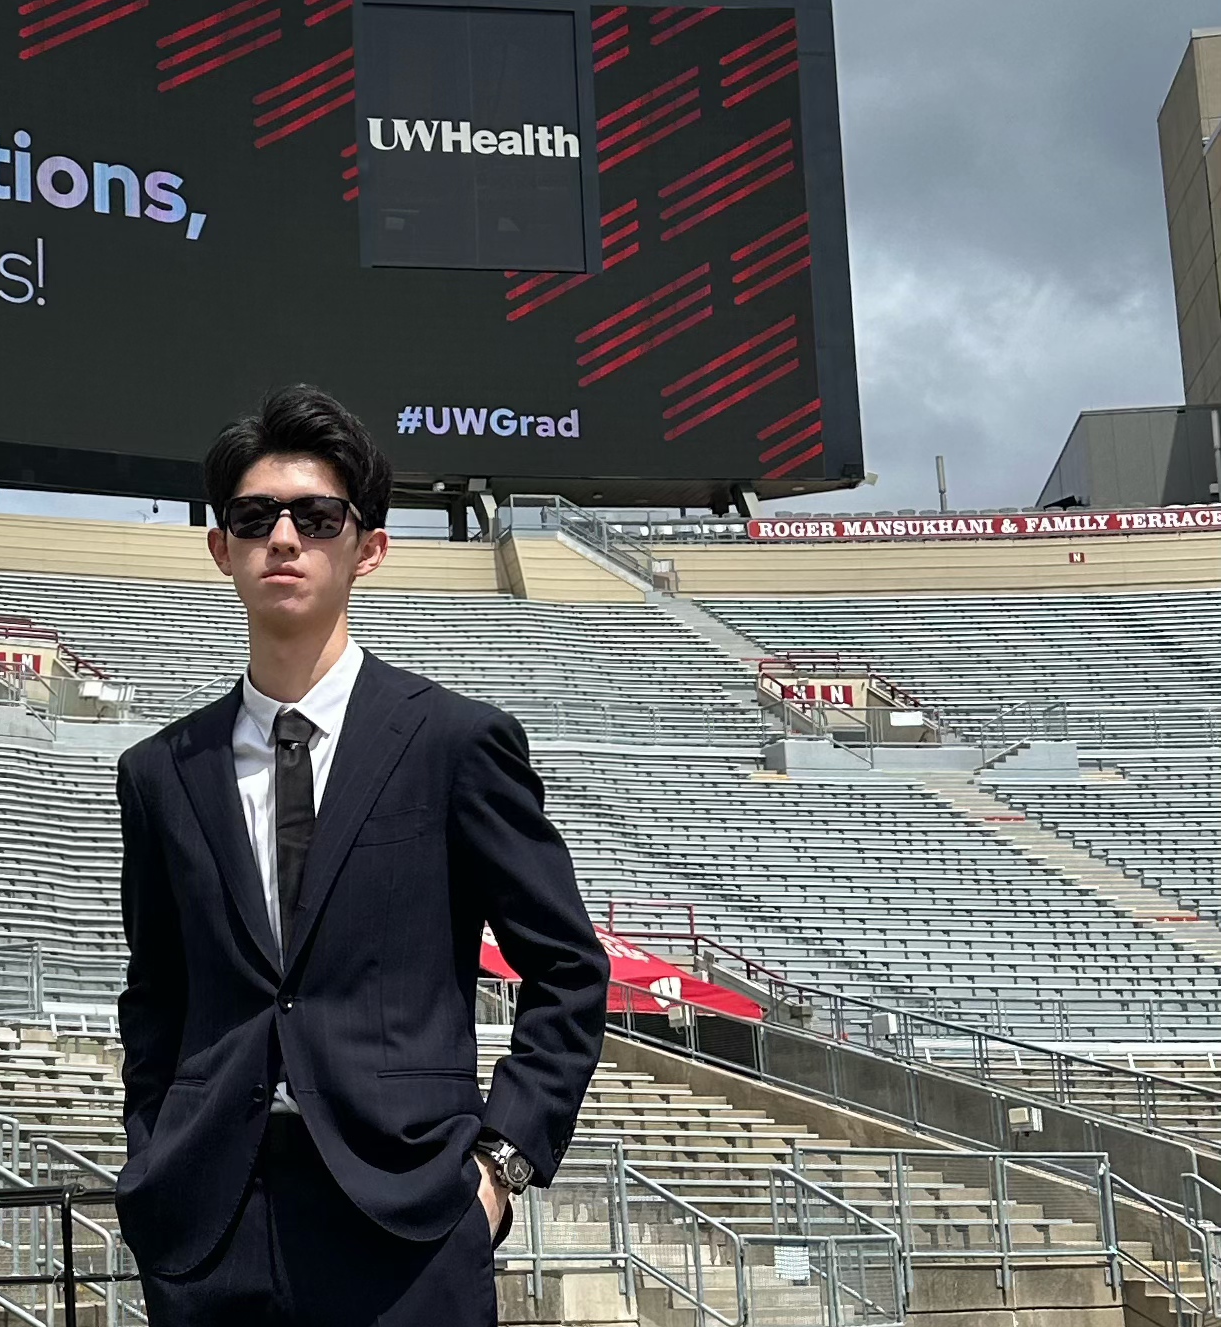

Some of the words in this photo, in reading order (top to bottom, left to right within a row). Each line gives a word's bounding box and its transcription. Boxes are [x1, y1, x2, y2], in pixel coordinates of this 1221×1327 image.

[366, 117, 580, 158] UWHealth
[396, 406, 580, 439] #UWGrad
[758, 521, 838, 538] ROGER
[842, 518, 994, 537] MANSUKHANI
[1000, 518, 1018, 534] &
[1024, 515, 1110, 533] FAMILY
[1116, 510, 1221, 530] TERRACE
[830, 685, 844, 703] N
